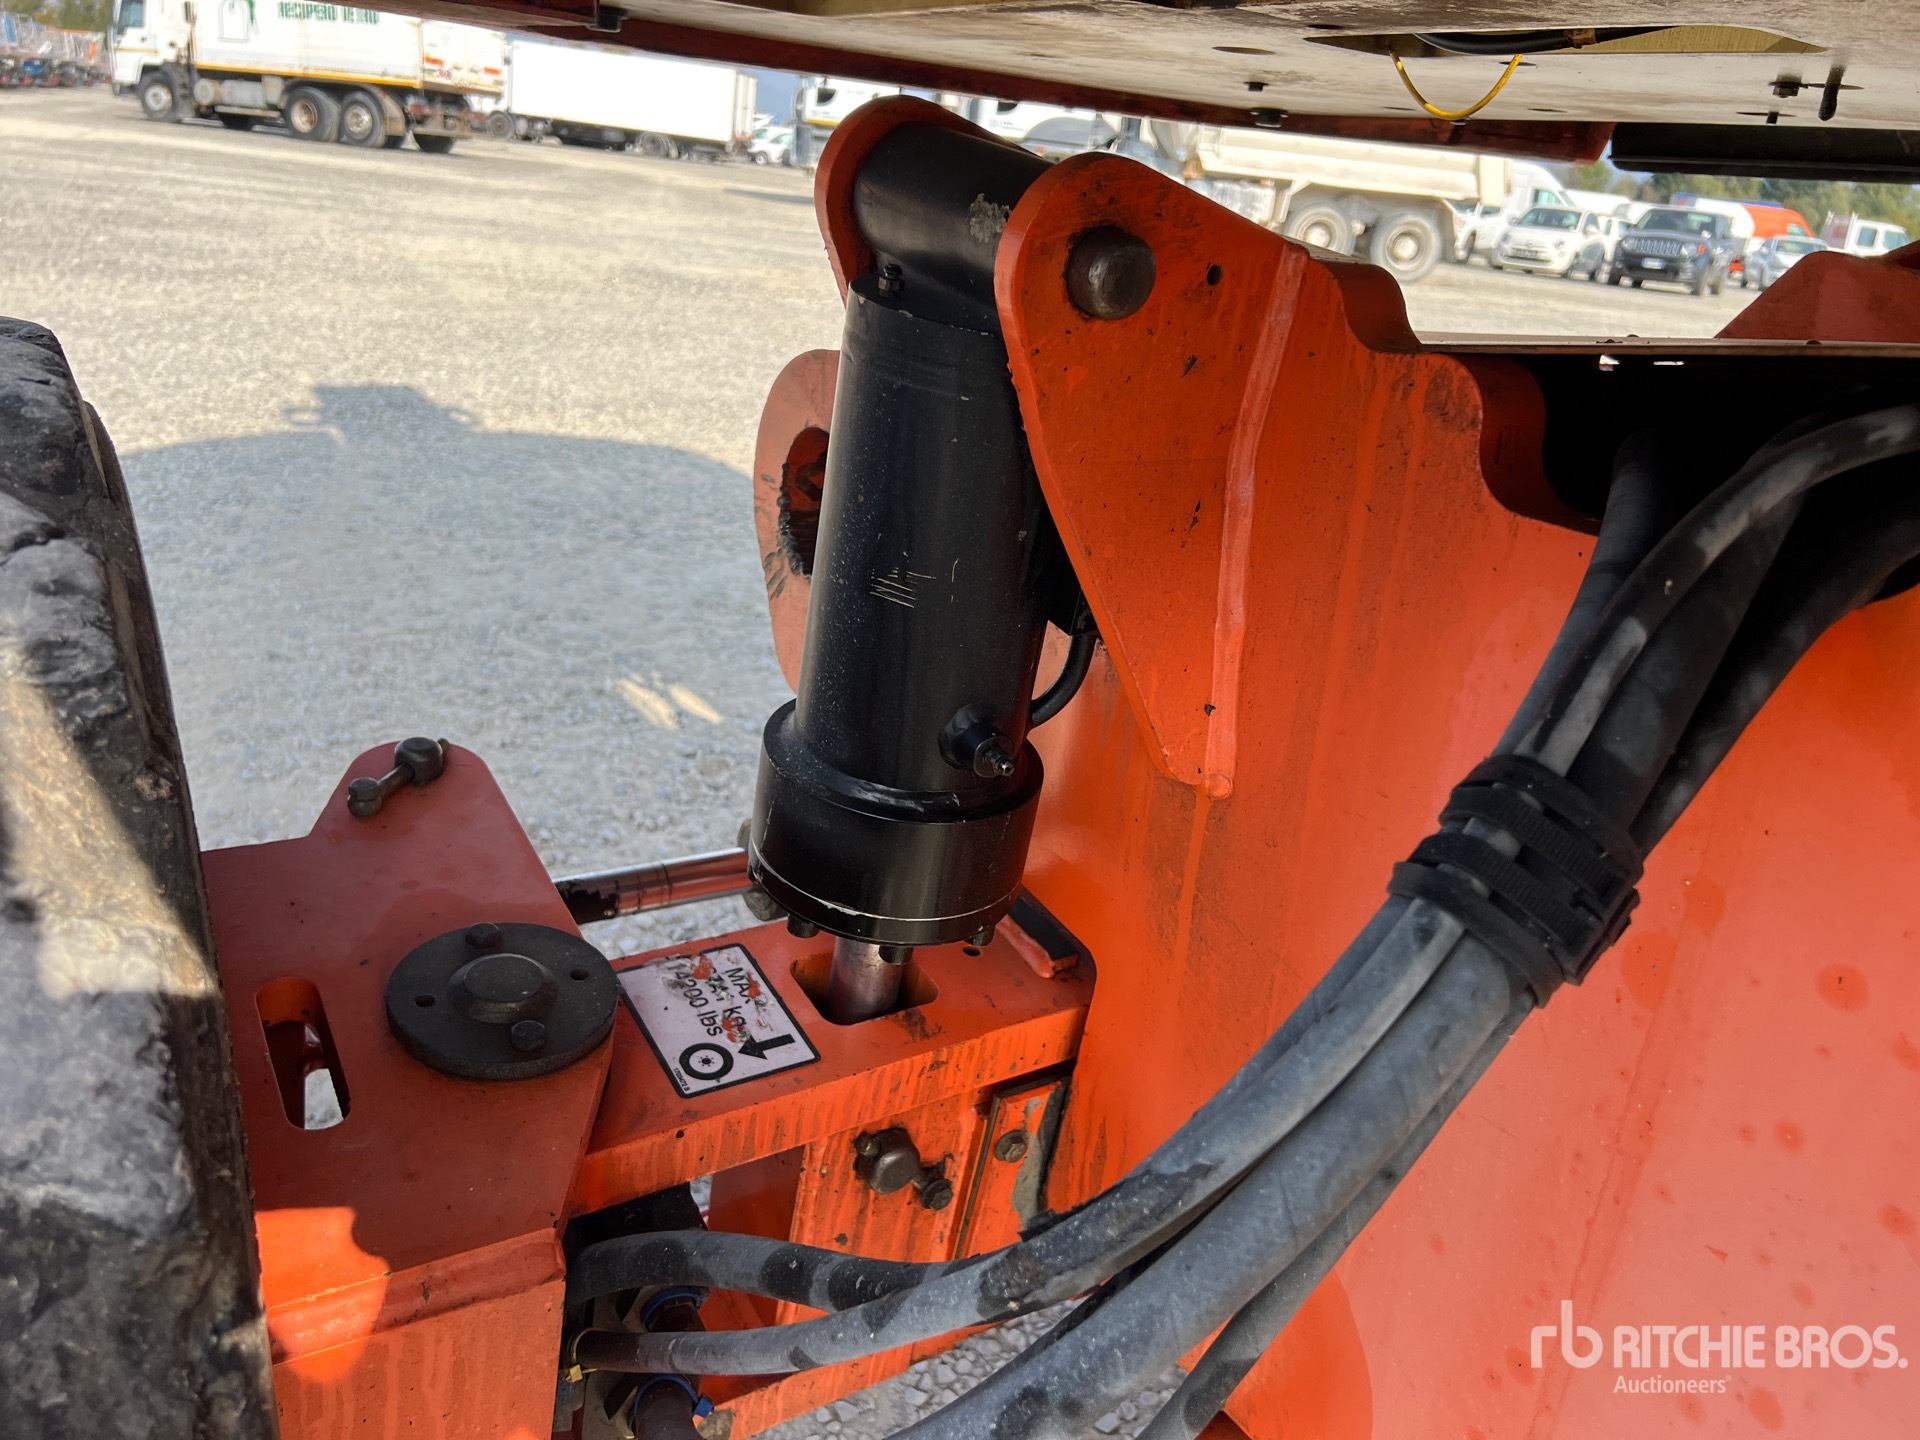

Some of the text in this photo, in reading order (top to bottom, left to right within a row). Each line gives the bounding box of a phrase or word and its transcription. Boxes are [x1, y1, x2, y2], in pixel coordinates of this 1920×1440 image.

[278, 2, 337, 21] RECUPERO
[668, 963, 724, 1037] 14200 lbs
